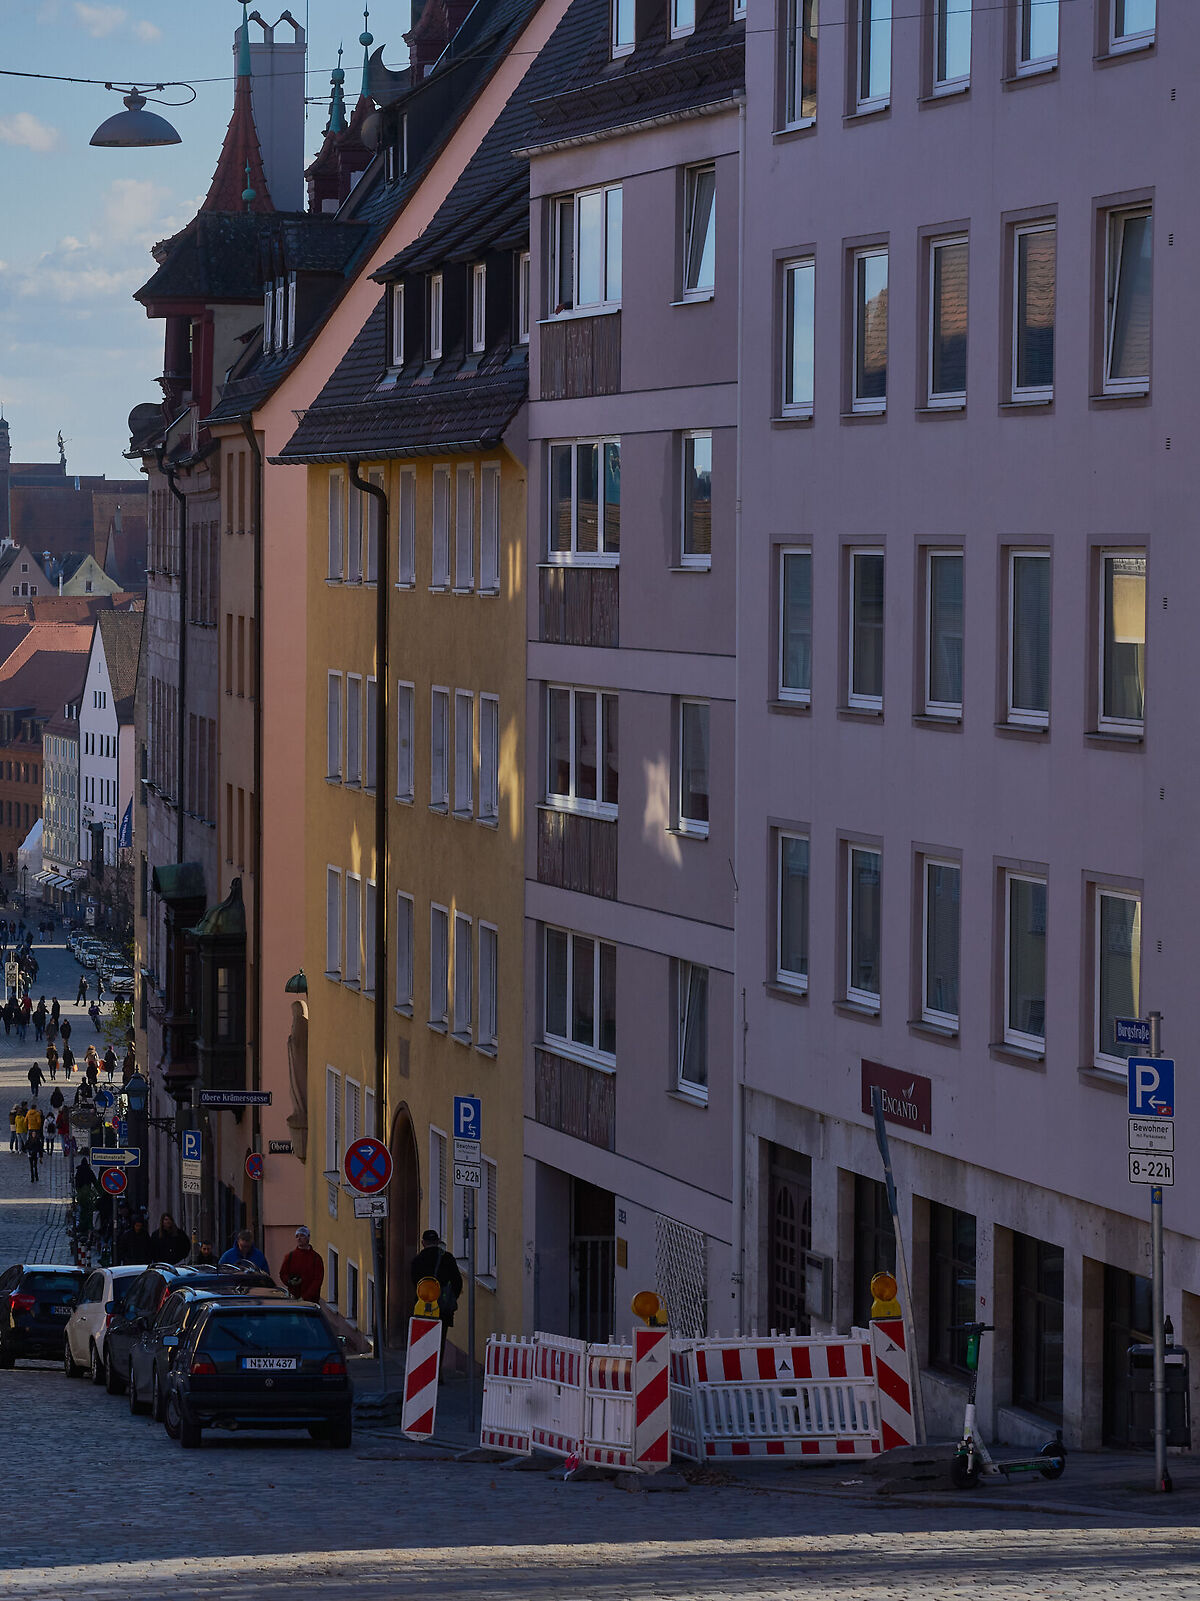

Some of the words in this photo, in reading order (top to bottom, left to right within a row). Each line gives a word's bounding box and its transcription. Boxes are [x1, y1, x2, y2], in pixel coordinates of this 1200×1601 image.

[1117, 1022, 1150, 1041] Burgstraße
[1136, 1065, 1160, 1108] P
[201, 1093, 220, 1102] Obere
[222, 1093, 268, 1104] Krämersgasse
[460, 1102, 475, 1133] P
[1133, 1122, 1169, 1133] Bewohner
[185, 1134, 196, 1156] P
[271, 1142, 289, 1151] Obere
[456, 1169, 479, 1183] 8-22h
[1132, 1160, 1170, 1178] 8-22h
[250, 1359, 257, 1368] N
[276, 1358, 293, 1368] 437
